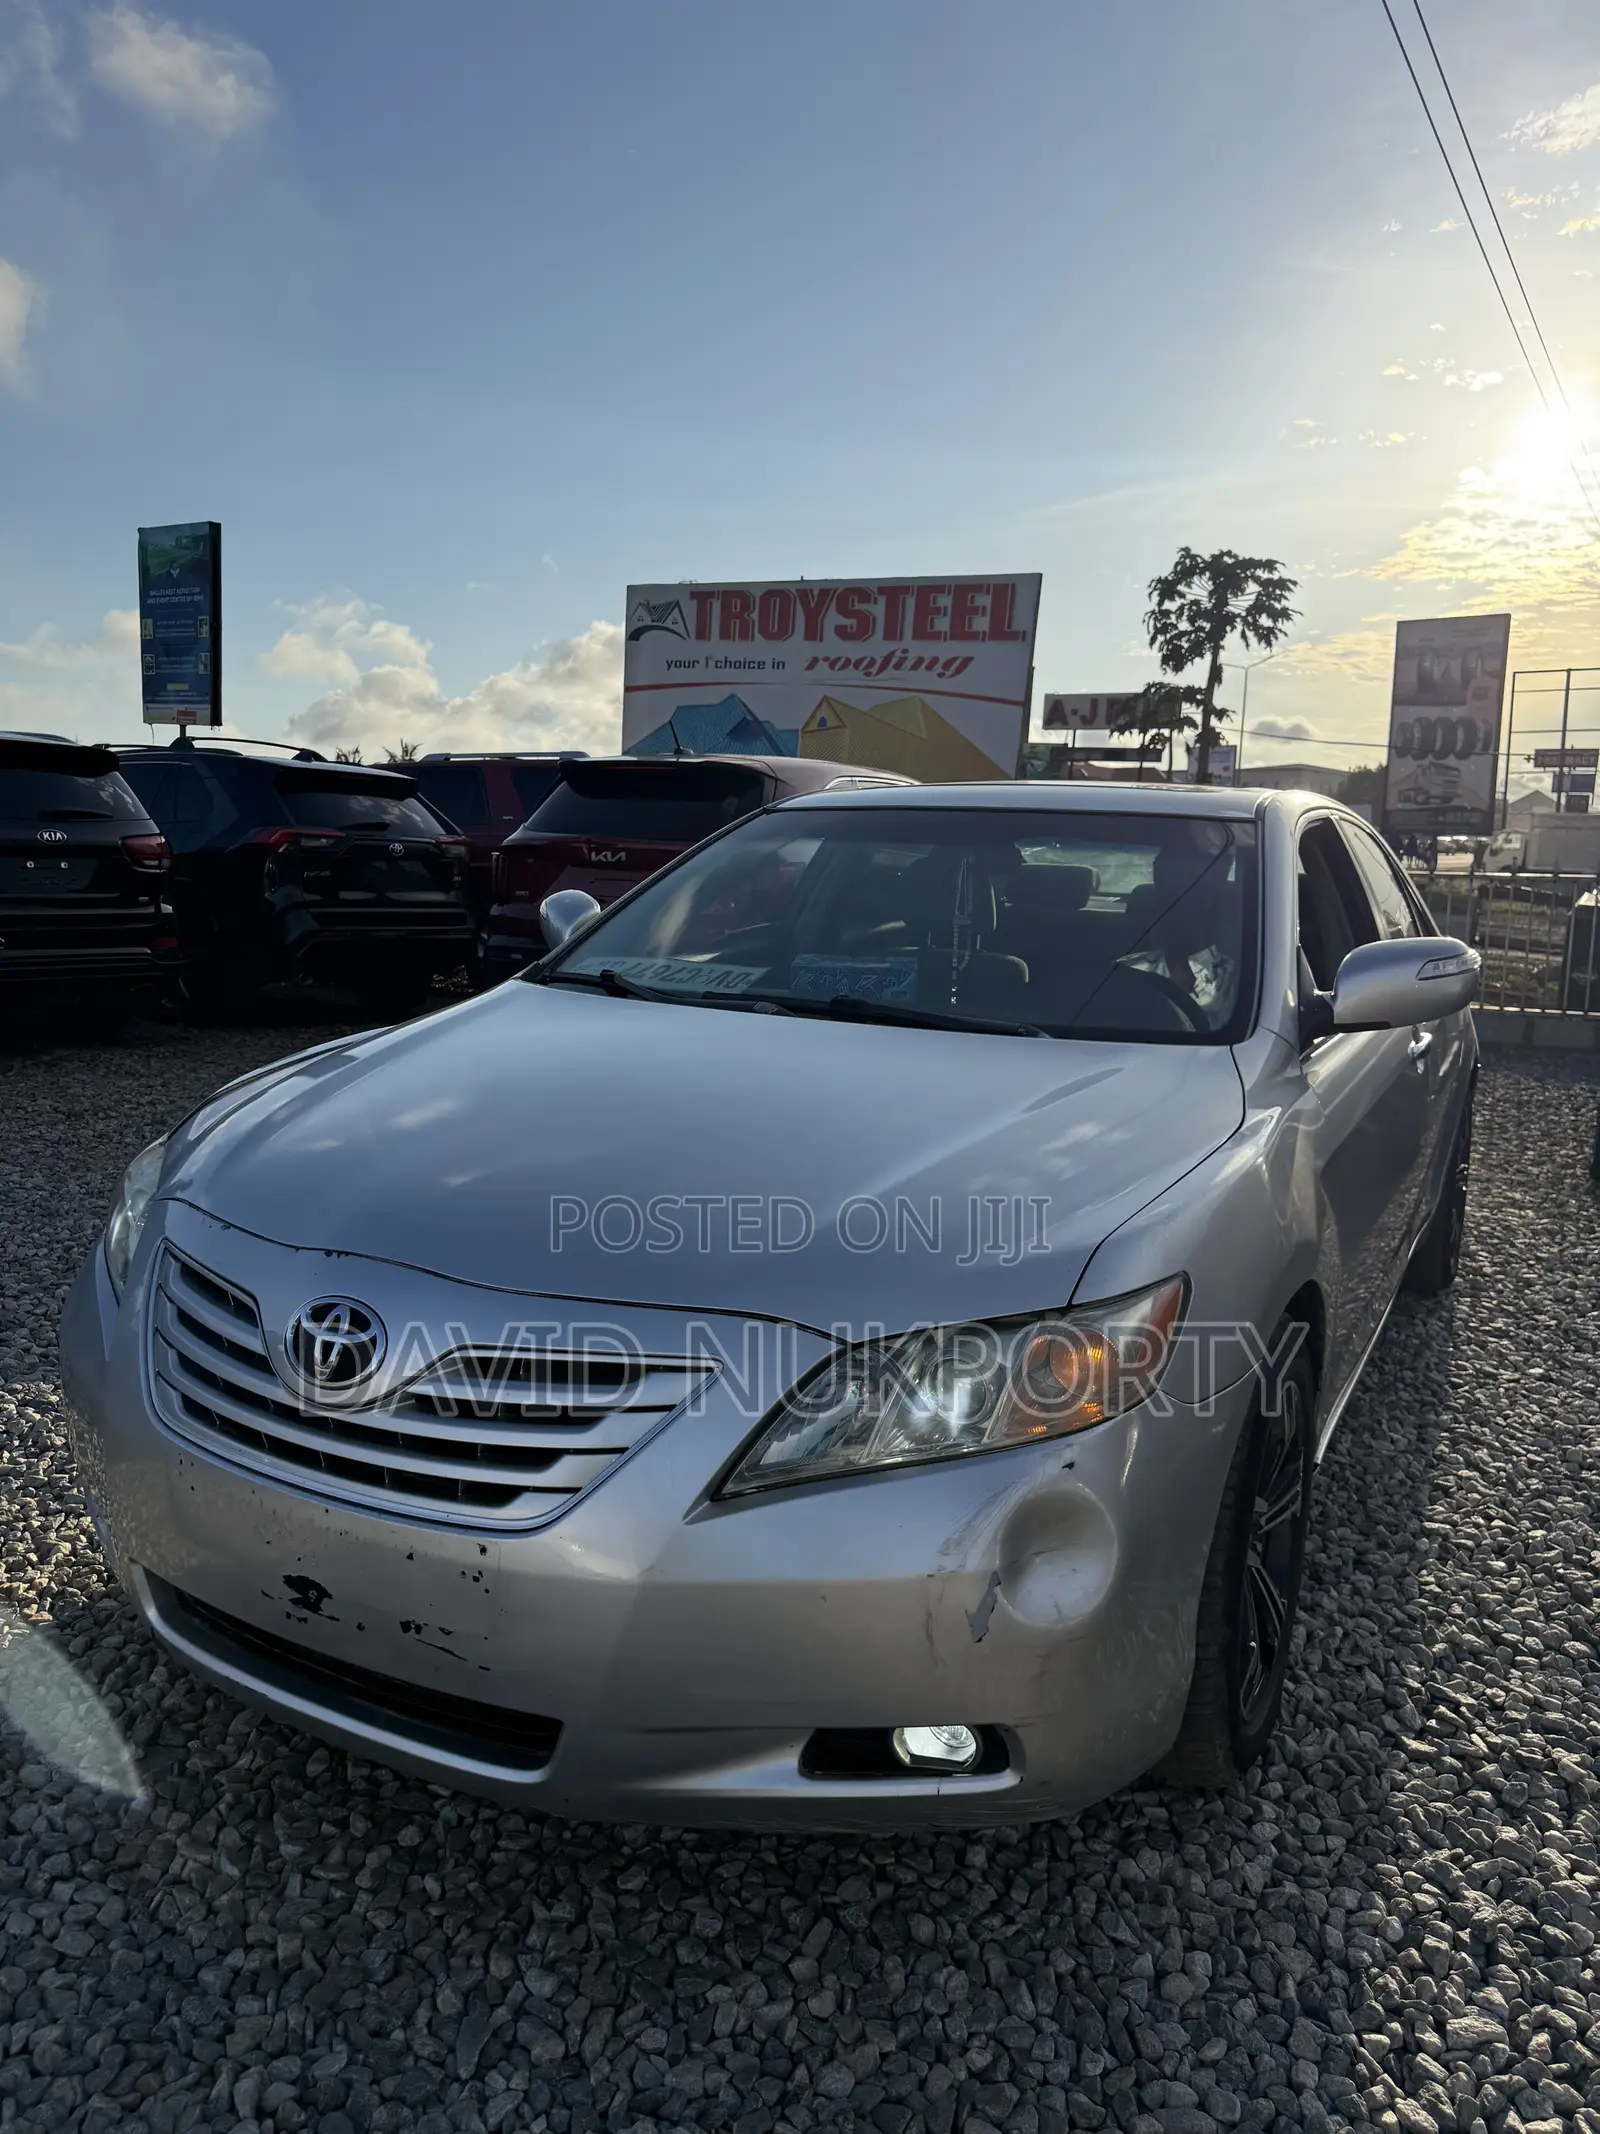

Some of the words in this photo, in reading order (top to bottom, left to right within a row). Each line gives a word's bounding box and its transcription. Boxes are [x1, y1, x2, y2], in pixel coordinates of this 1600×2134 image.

[689, 583, 1027, 644] TROYSTEEL
[666, 659, 700, 671] your
[715, 656, 766, 670] choice
[771, 657, 786, 670] in
[803, 648, 975, 678] roofing
